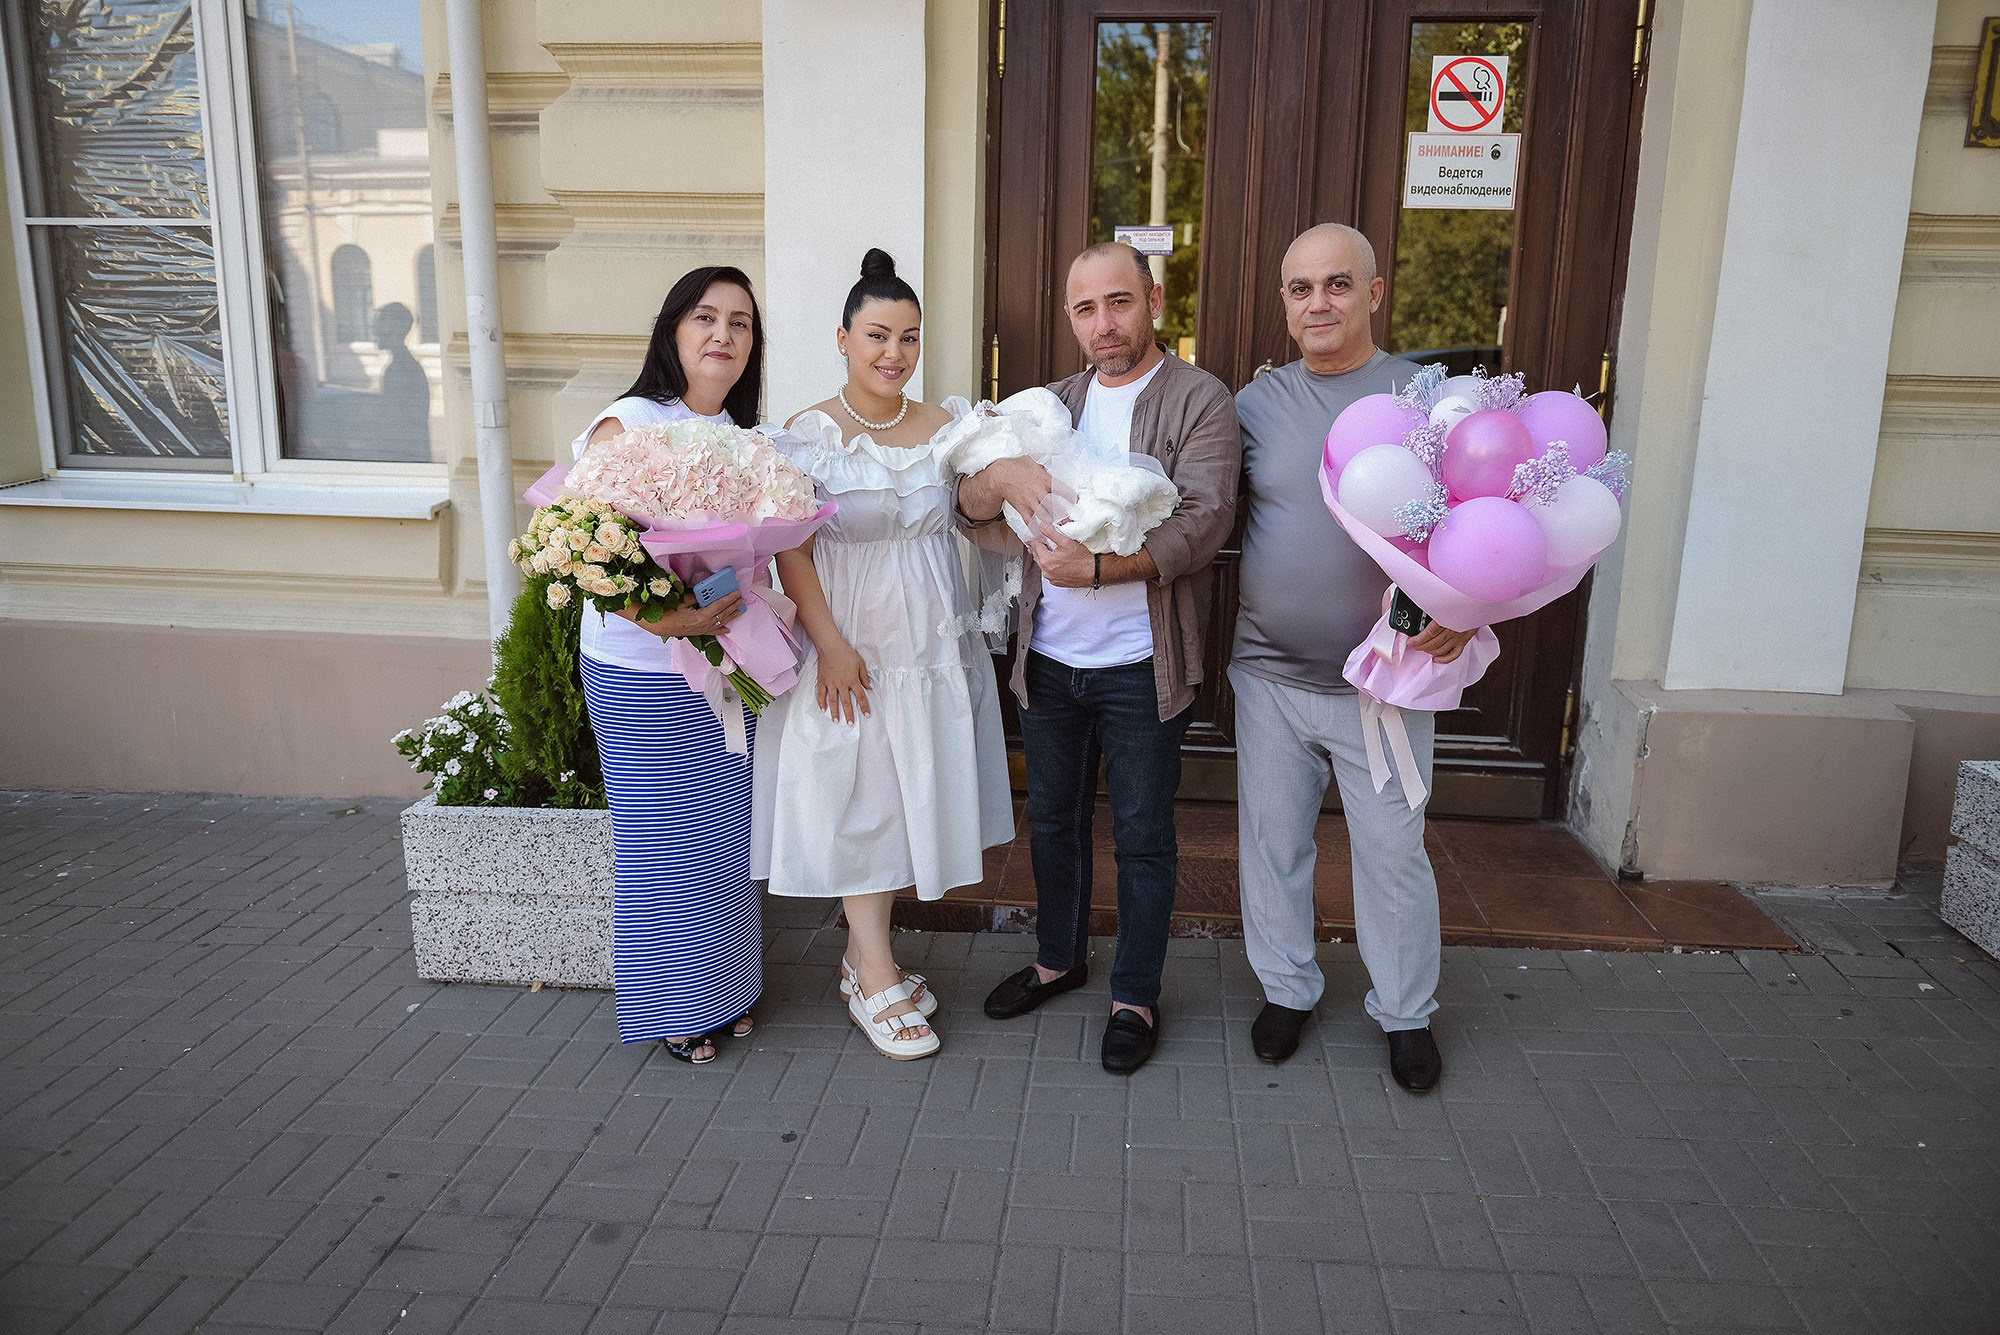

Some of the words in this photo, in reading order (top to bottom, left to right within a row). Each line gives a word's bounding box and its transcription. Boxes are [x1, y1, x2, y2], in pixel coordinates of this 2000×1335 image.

[1418, 145, 1484, 157] ВНИМАНИЕ!
[1438, 166, 1483, 179] Ведется
[1411, 183, 1512, 197] видеонаблюдение
